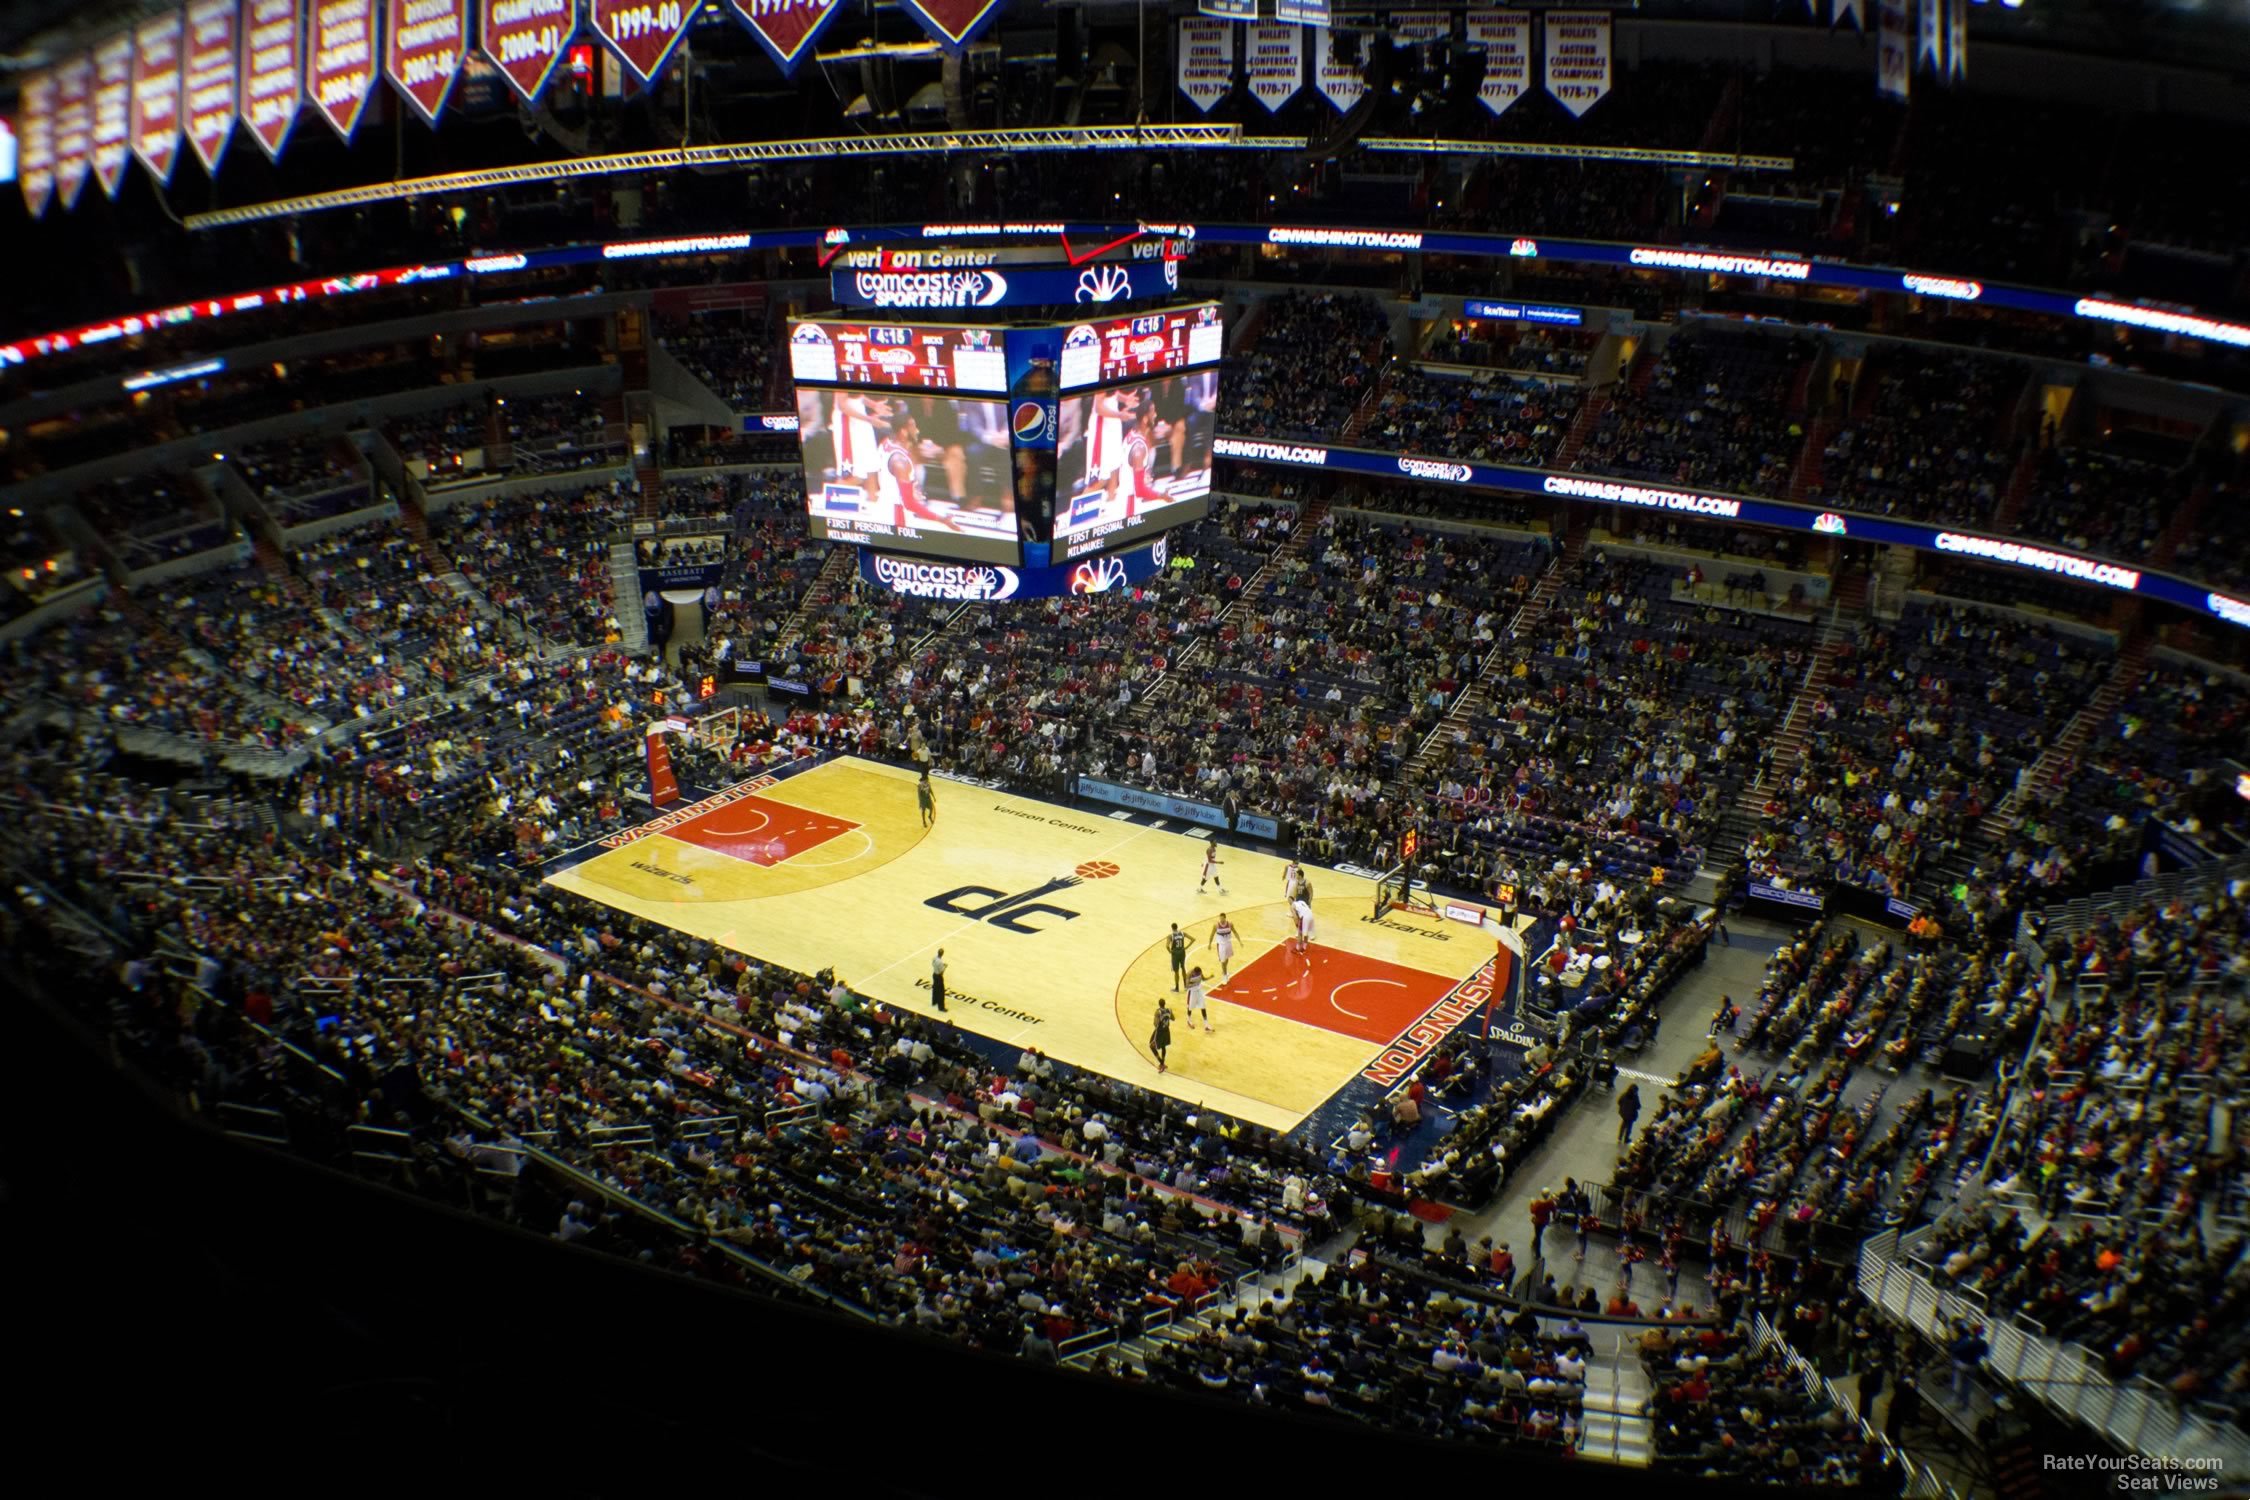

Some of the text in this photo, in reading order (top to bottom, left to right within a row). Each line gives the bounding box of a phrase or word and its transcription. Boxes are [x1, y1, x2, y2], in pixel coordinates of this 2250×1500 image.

[610, 1, 681, 41] 1999-00
[1191, 32, 1222, 41] BULLETS
[1258, 30, 1291, 39] BULLETS
[1480, 27, 1516, 37] BULLETS
[1559, 28, 1597, 38] BULLETS
[1191, 47, 1222, 56] CENTRAL
[1258, 46, 1290, 54] EASTERN
[1559, 45, 1596, 55] EASTERN
[1250, 56, 1298, 66] CONFERENCE
[1550, 56, 1606, 67] CONFERENCE
[1184, 68, 1227, 78] CHAMPIONS
[1250, 67, 1296, 77] CHAMPIONS
[1551, 68, 1604, 79] CHAMPIONS
[1256, 83, 1291, 95] 1970-71
[1556, 85, 1599, 98] 1978-79
[1268, 228, 1422, 248] CSNWASHINGTON.COM
[1131, 237, 1187, 260] verizon
[847, 247, 997, 271] verizon Center
[860, 272, 953, 297] comcast
[874, 291, 980, 307] SPORTSNET
[1046, 405, 1057, 441] pepsi
[1544, 477, 1741, 518] CSNWASHINGTON.COM
[826, 518, 923, 539] FIRST PERSONAL FOUL.
[1068, 530, 1090, 545] FIRST
[1092, 521, 1124, 540] PERSONAL
[1067, 537, 1105, 558] MILWAUKEE
[657, 567, 705, 576] MASERATI
[875, 555, 966, 584] comcast
[892, 579, 996, 600] SPORTSNET
[598, 774, 780, 850] WASHINGTON
[993, 804, 1100, 835] Verizon Center
[629, 860, 695, 886] wizards
[1360, 915, 1453, 942] wizards
[1175, 938, 1183, 948] 31
[914, 978, 1044, 1025] Veizon Center
[1488, 1025, 1537, 1048] SPALDIN
